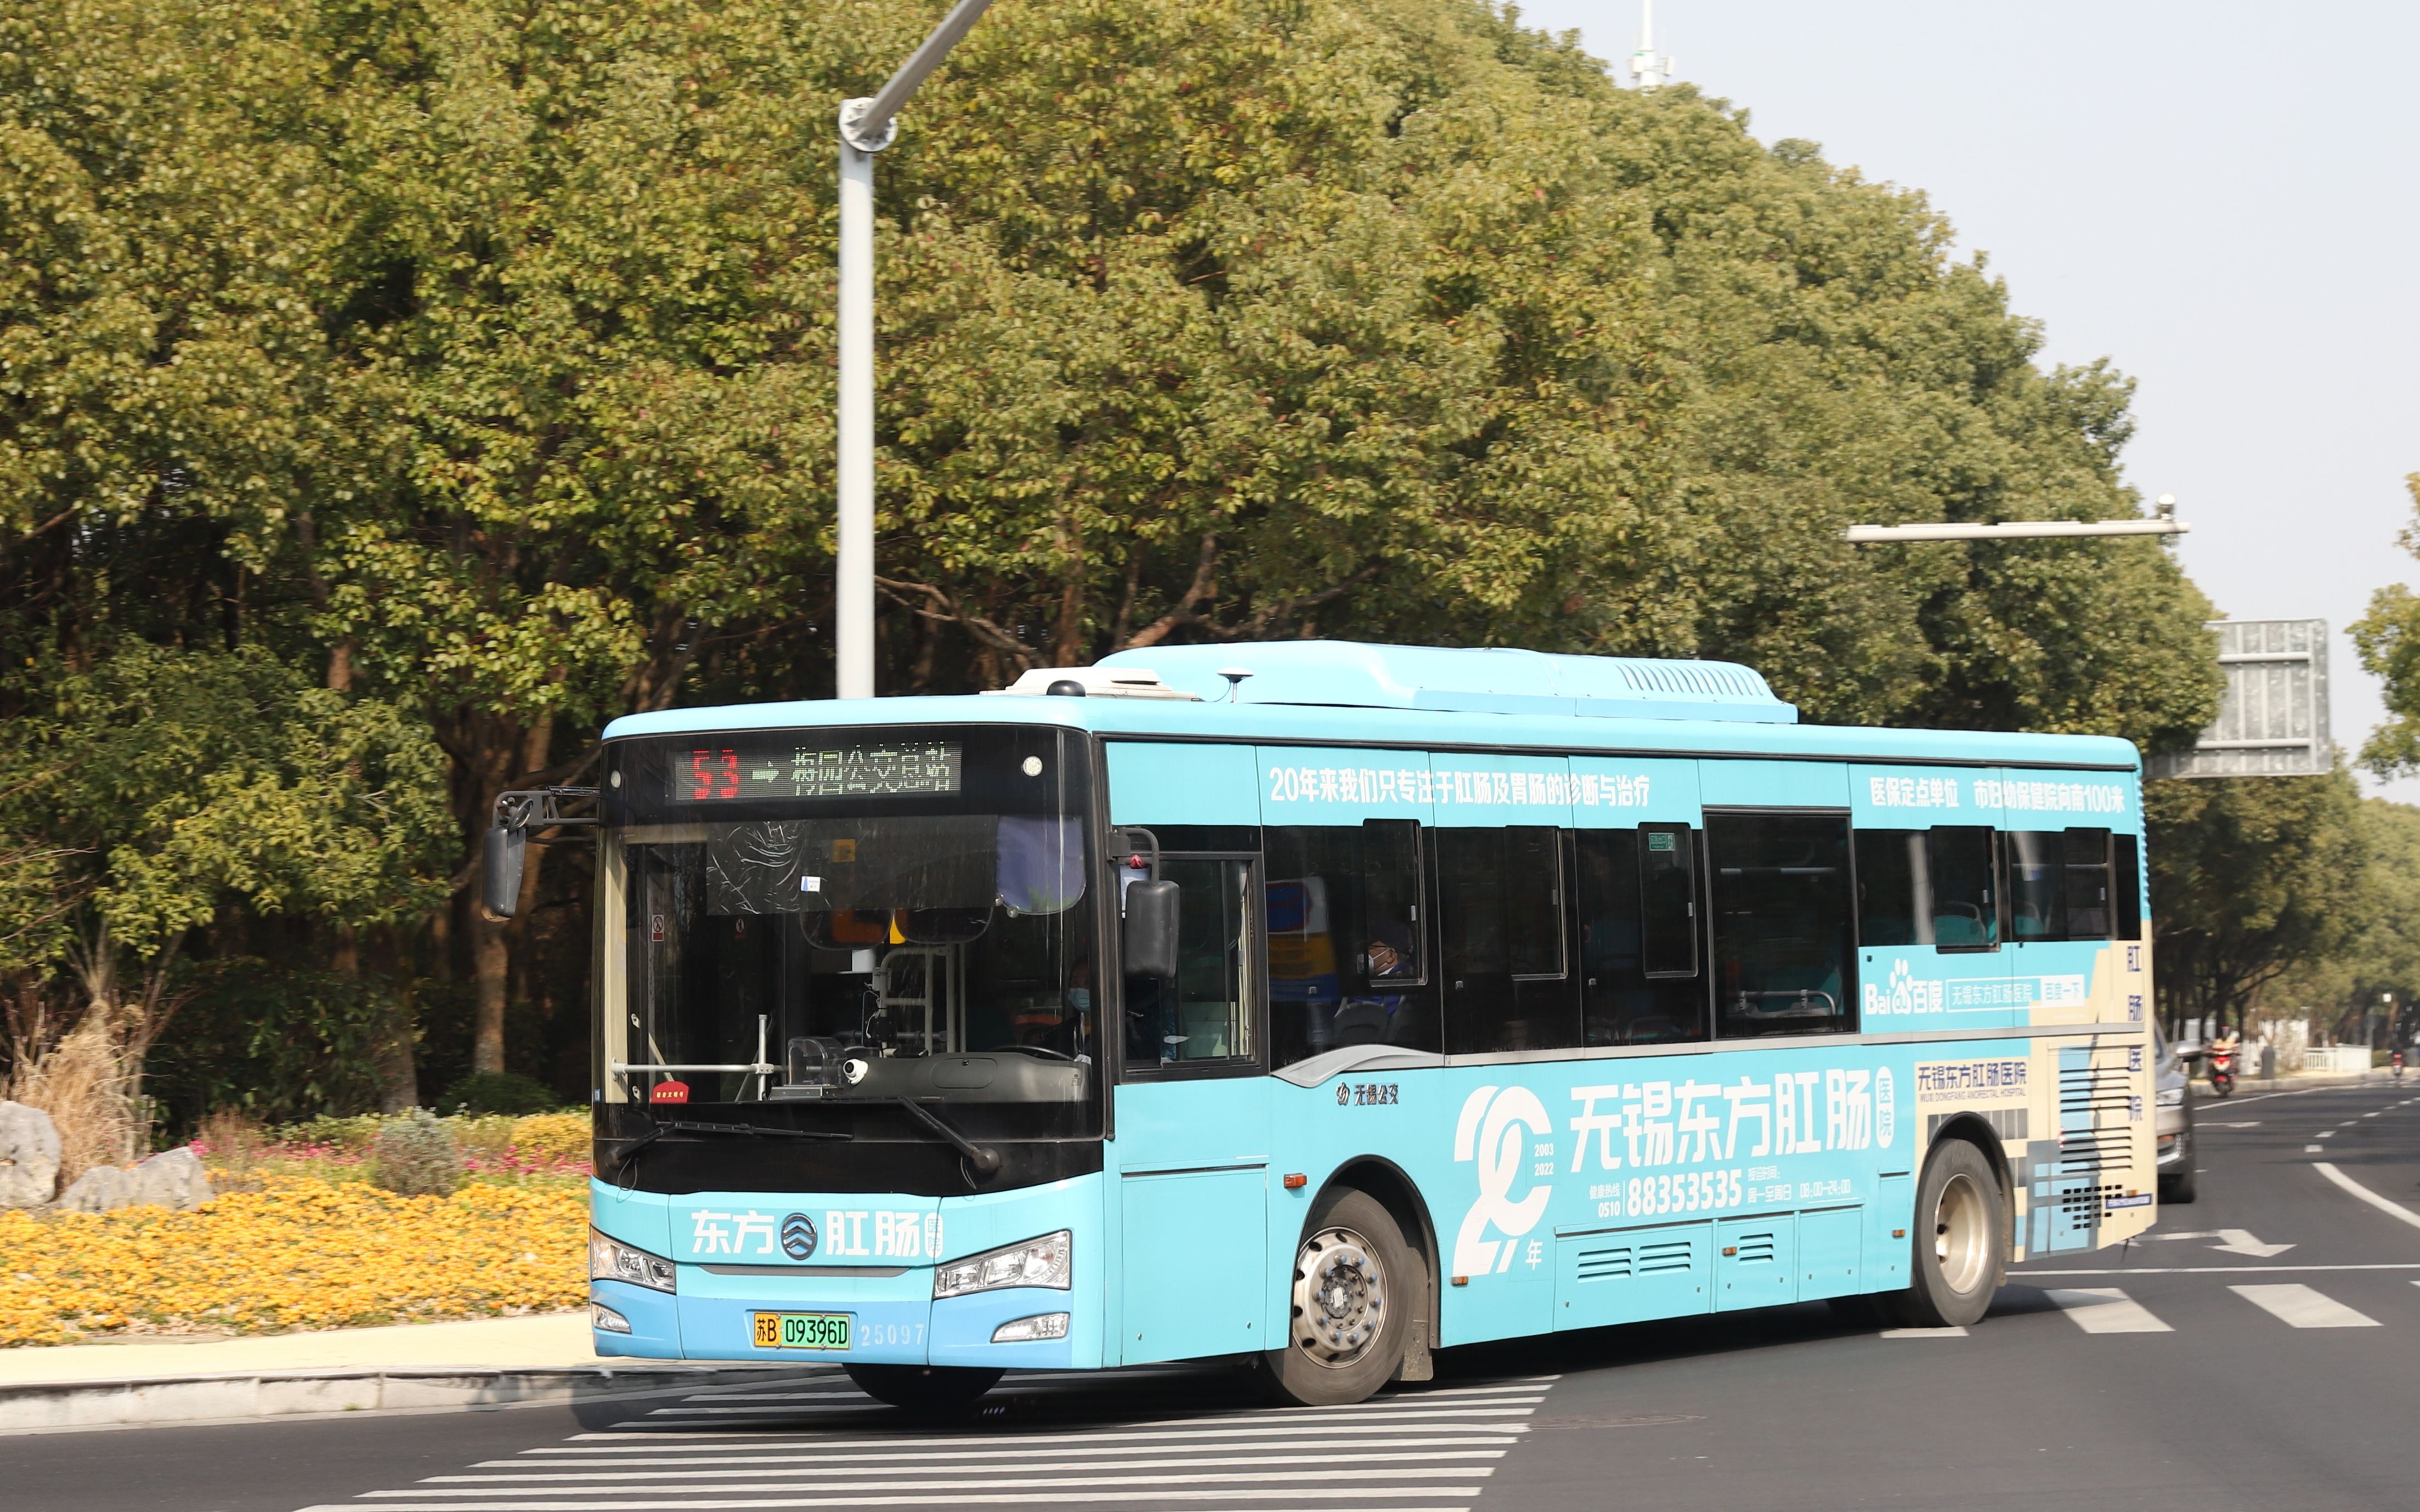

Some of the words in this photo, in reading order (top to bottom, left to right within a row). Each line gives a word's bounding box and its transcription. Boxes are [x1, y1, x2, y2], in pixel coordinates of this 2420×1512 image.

[693, 749, 738, 799] 53
[1269, 767, 1650, 807] 20年来我们只专注于肛肠及胃肠的诊断与治疗
[1869, 777, 1960, 808] 医保定点单位
[1919, 1062, 2026, 1091] 无锡东方肛肠医院
[1354, 1084, 1398, 1106] 无锡公交
[1570, 1068, 1871, 1173] 无锡东方肛肠
[1535, 1143, 1554, 1157] 2003
[1535, 1162, 1554, 1176] 2022
[1590, 1182, 1620, 1200] 健康热线
[1627, 1169, 1742, 1216] 88353535
[1748, 1184, 1791, 1203] 周一至周日
[1598, 1201, 1620, 1218] 0510
[691, 1210, 774, 1254] 东方
[826, 1211, 919, 1257] 肛肠
[928, 1219, 941, 1252] 医院
[1525, 1239, 1543, 1270] 年
[861, 1323, 924, 1346] 25097
